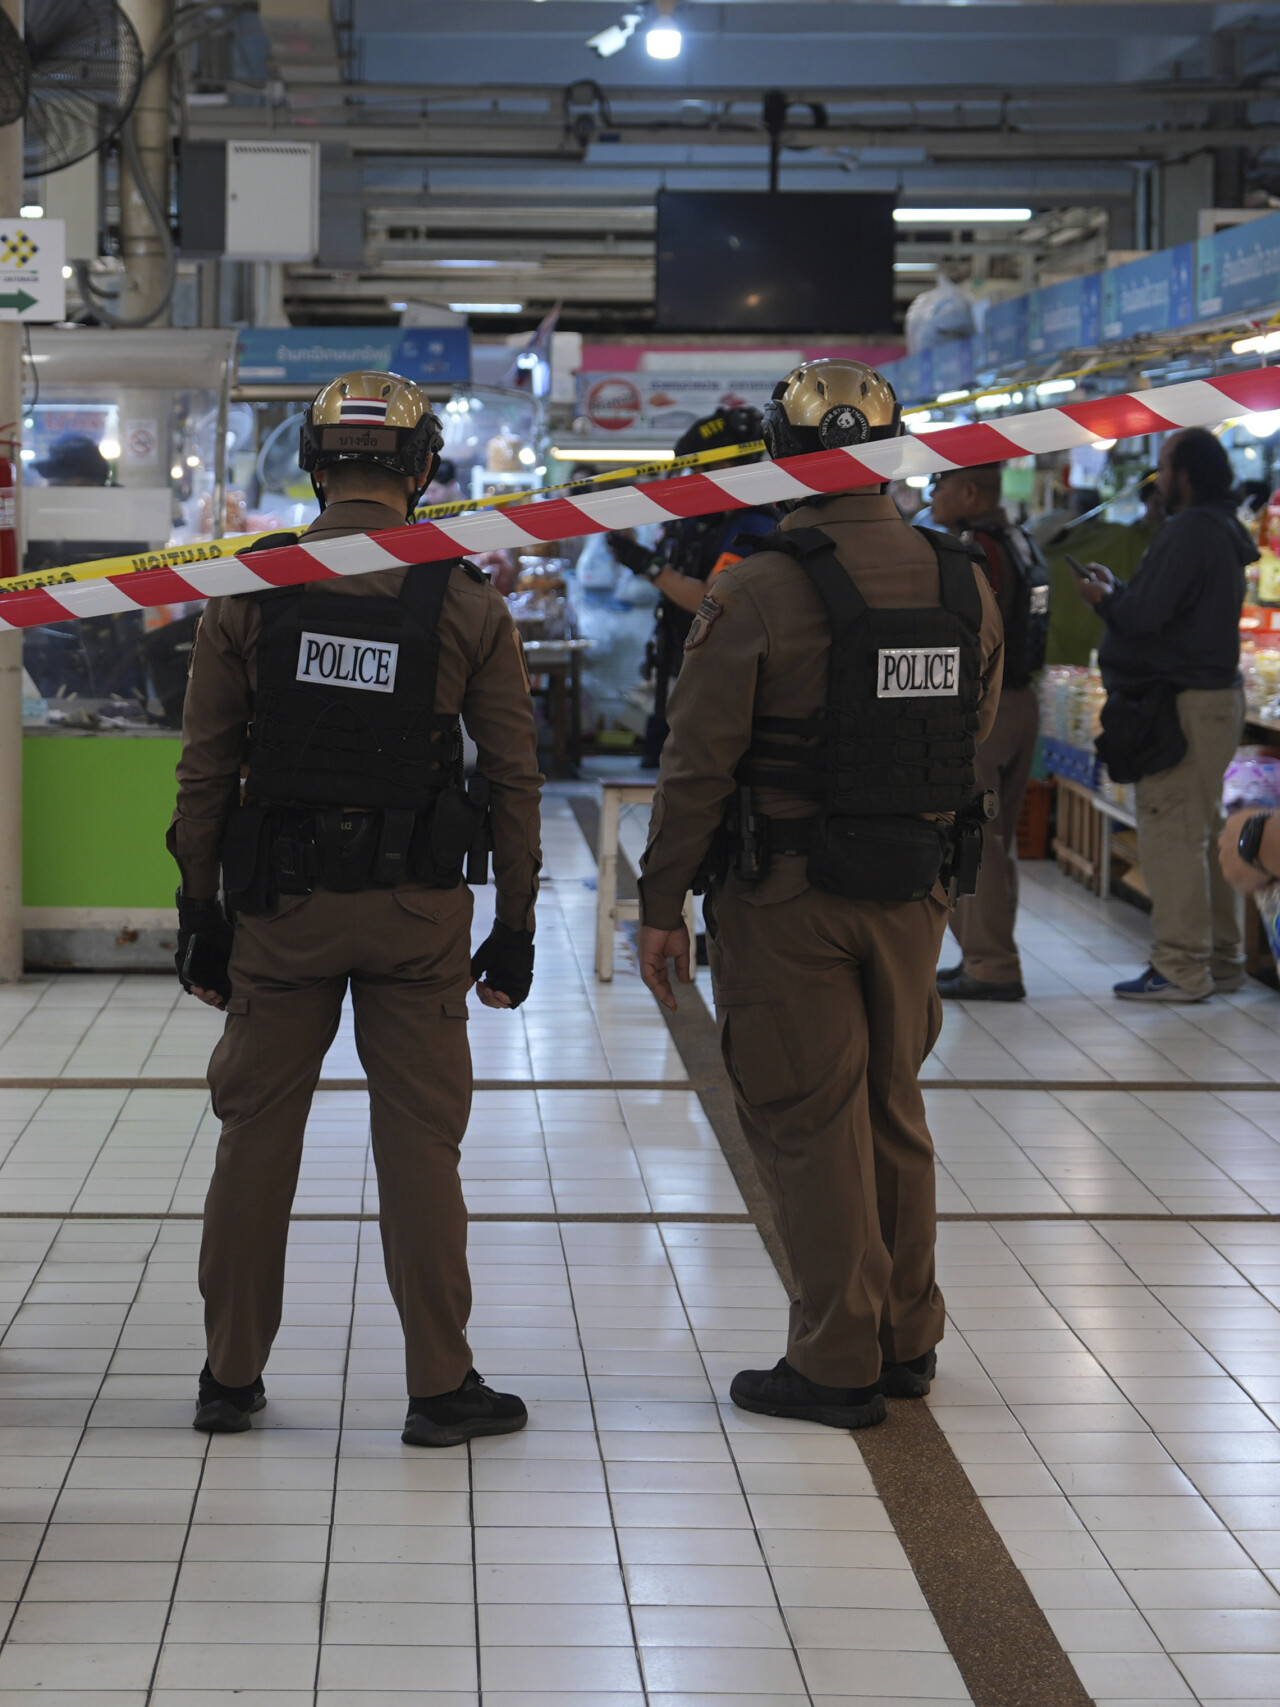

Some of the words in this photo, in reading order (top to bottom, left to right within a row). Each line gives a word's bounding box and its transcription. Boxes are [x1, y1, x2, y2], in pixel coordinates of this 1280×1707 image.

[338, 431, 378, 447] บางซื่อ
[303, 639, 391, 685] POLICE
[883, 654, 955, 690] POLICE
